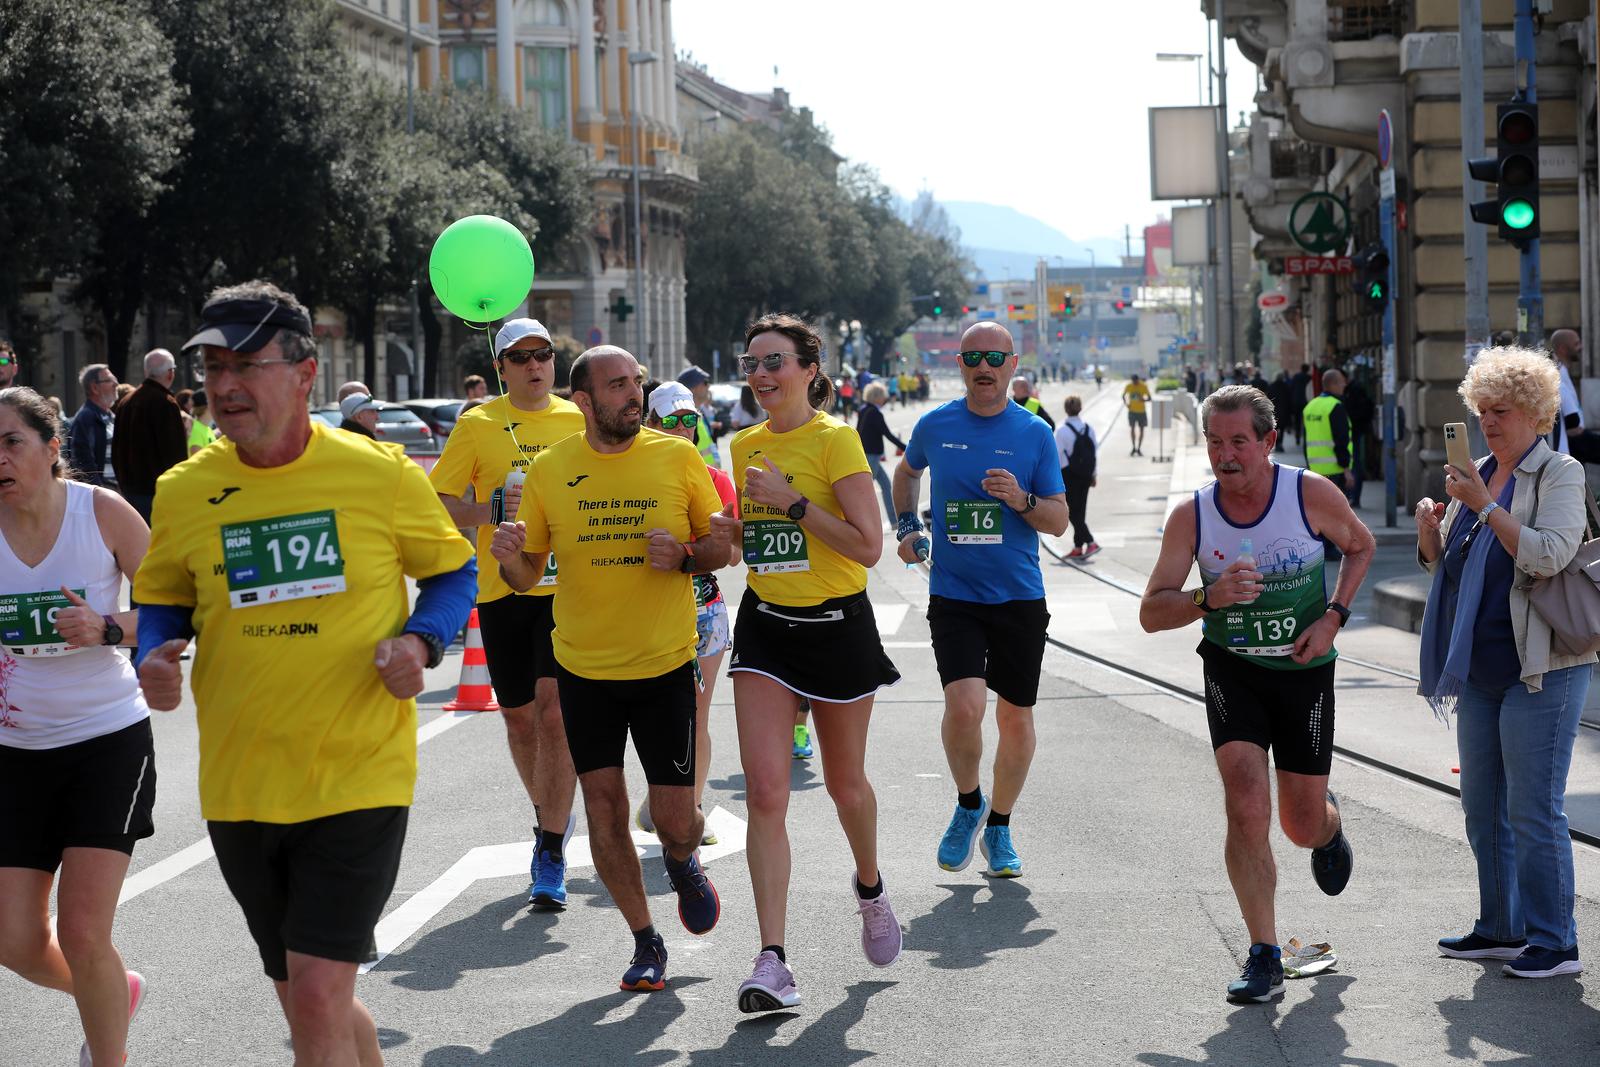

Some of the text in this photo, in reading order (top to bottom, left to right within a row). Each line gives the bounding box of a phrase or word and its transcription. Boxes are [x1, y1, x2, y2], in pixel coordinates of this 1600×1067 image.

[1290, 259, 1352, 273] SPAR
[519, 444, 540, 453] Most
[578, 498, 658, 511] There is magic
[752, 504, 764, 513] km
[588, 514, 645, 527] in misery!
[971, 510, 994, 529] 16
[225, 536, 252, 549] RUN
[576, 531, 647, 543] Just ask any run
[762, 531, 804, 556] 209
[266, 531, 338, 574] 194
[1264, 575, 1312, 592] MAKSIMIR
[1253, 616, 1297, 641] 139
